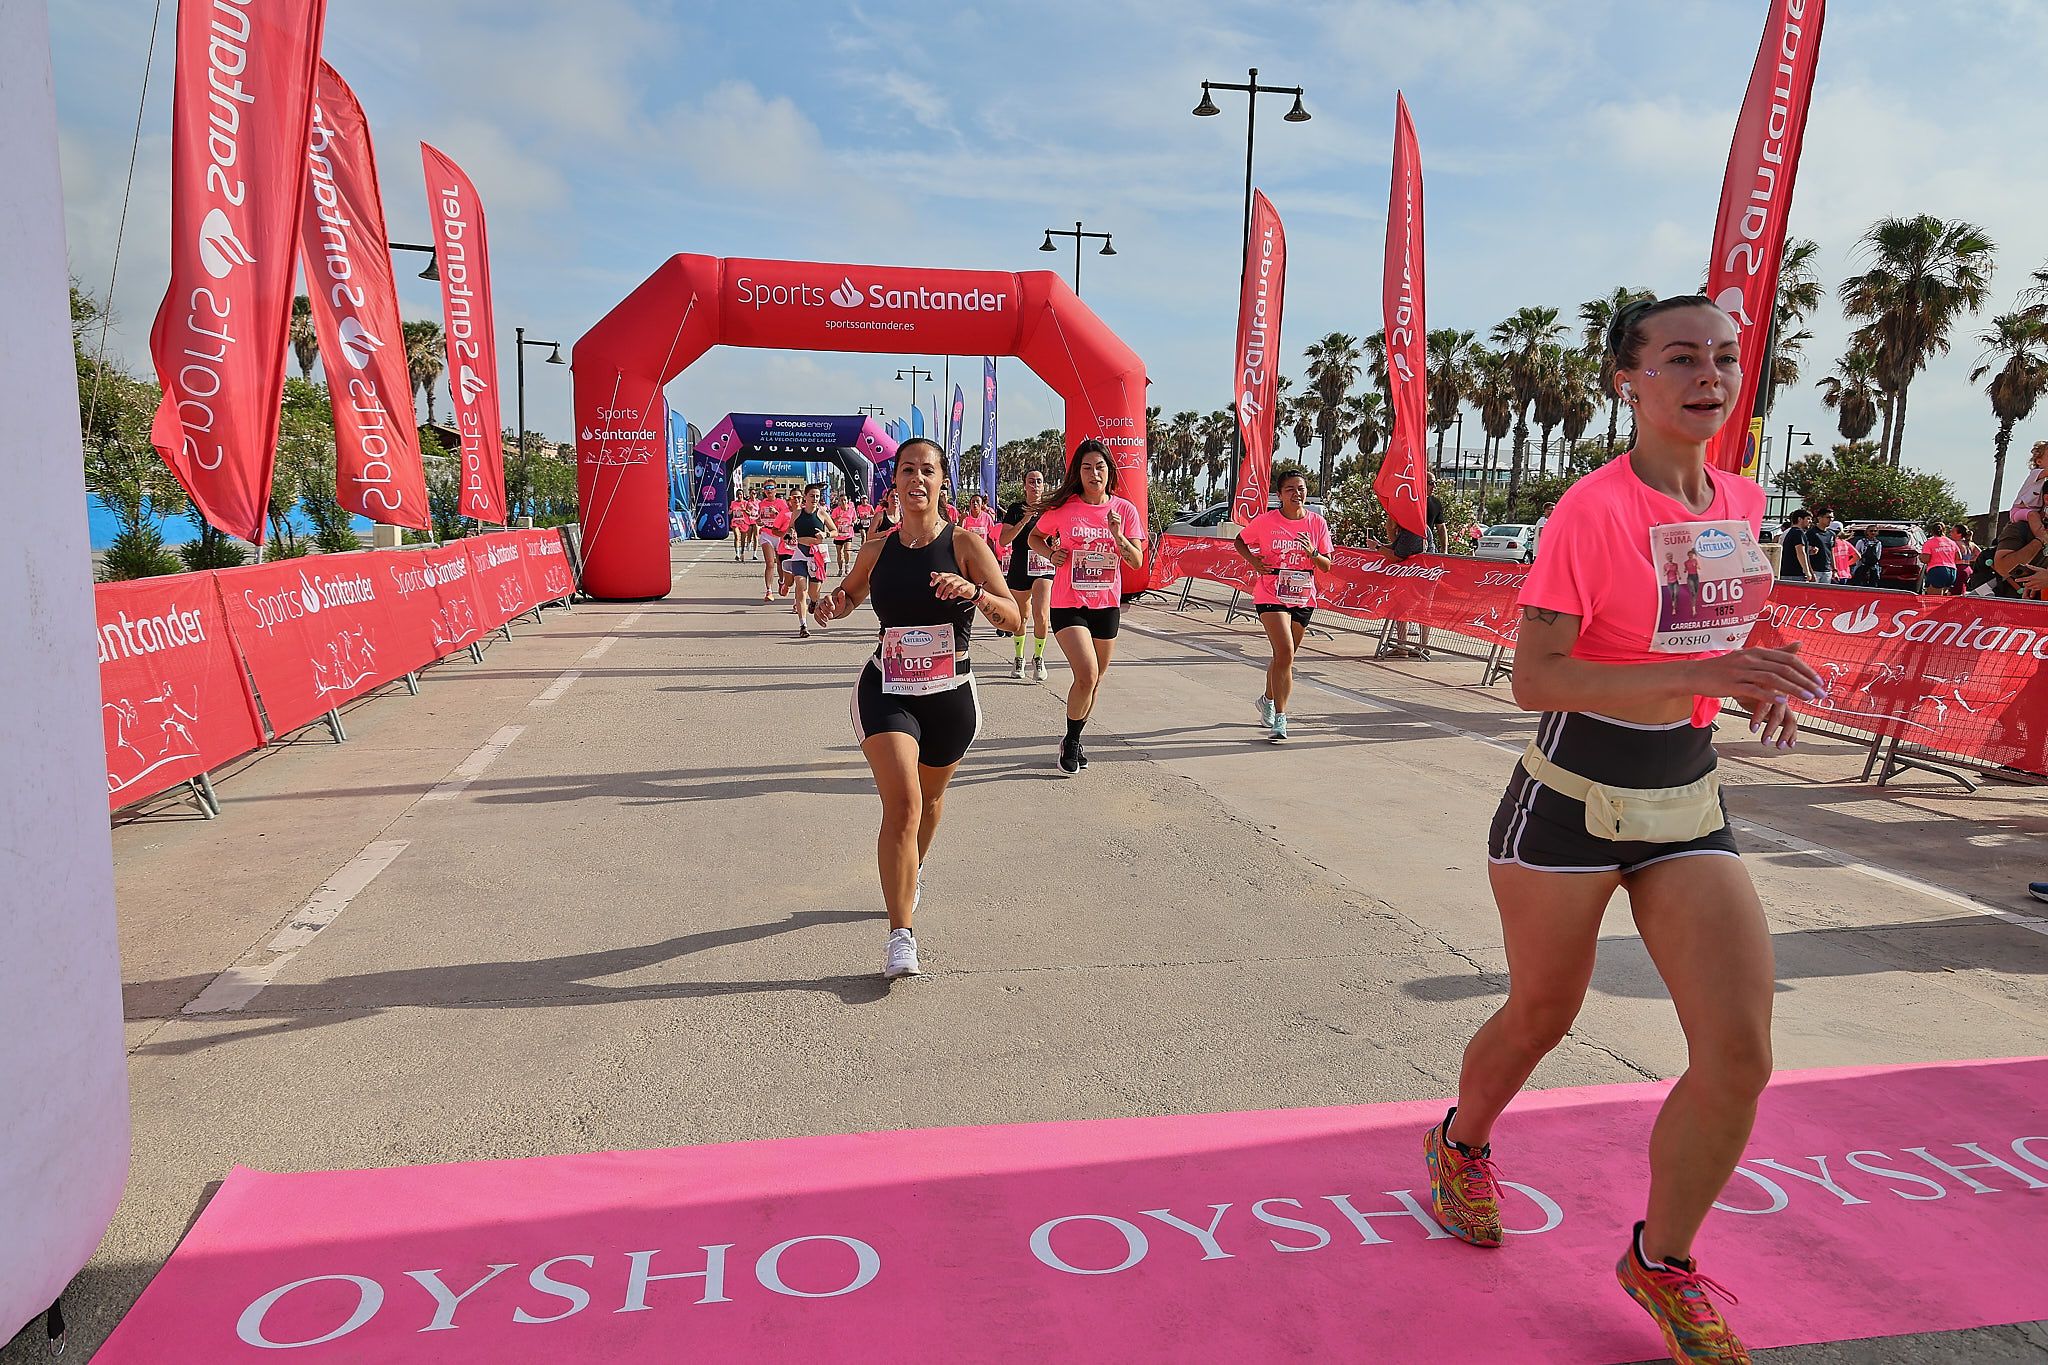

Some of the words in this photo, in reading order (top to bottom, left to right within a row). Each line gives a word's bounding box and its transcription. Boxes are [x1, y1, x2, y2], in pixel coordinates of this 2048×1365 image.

[737, 277, 824, 311] Sports
[868, 283, 1006, 312] Santander
[825, 318, 915, 332] sportssantander.es
[597, 406, 639, 421] Sports
[1098, 416, 1134, 429] Sports
[594, 429, 656, 441] Santander
[1664, 535, 1693, 545] SUMA
[390, 565, 426, 600] Sports
[433, 556, 467, 585] Santander
[1086, 568, 1103, 576] 016
[1702, 578, 1744, 604] 016
[243, 586, 303, 636] Sports
[315, 572, 374, 608] Santander
[1715, 605, 1735, 616] 1875
[1670, 621, 1700, 630] CARRERA
[1702, 620, 1710, 628] DE
[1711, 619, 1719, 627] LA
[1721, 616, 1739, 625] MUJER
[1668, 634, 1711, 646] OYSHO
[904, 657, 933, 670] 016
[1030, 1181, 1564, 1275] OYSHO
[235, 1233, 881, 1349] OYSHO
